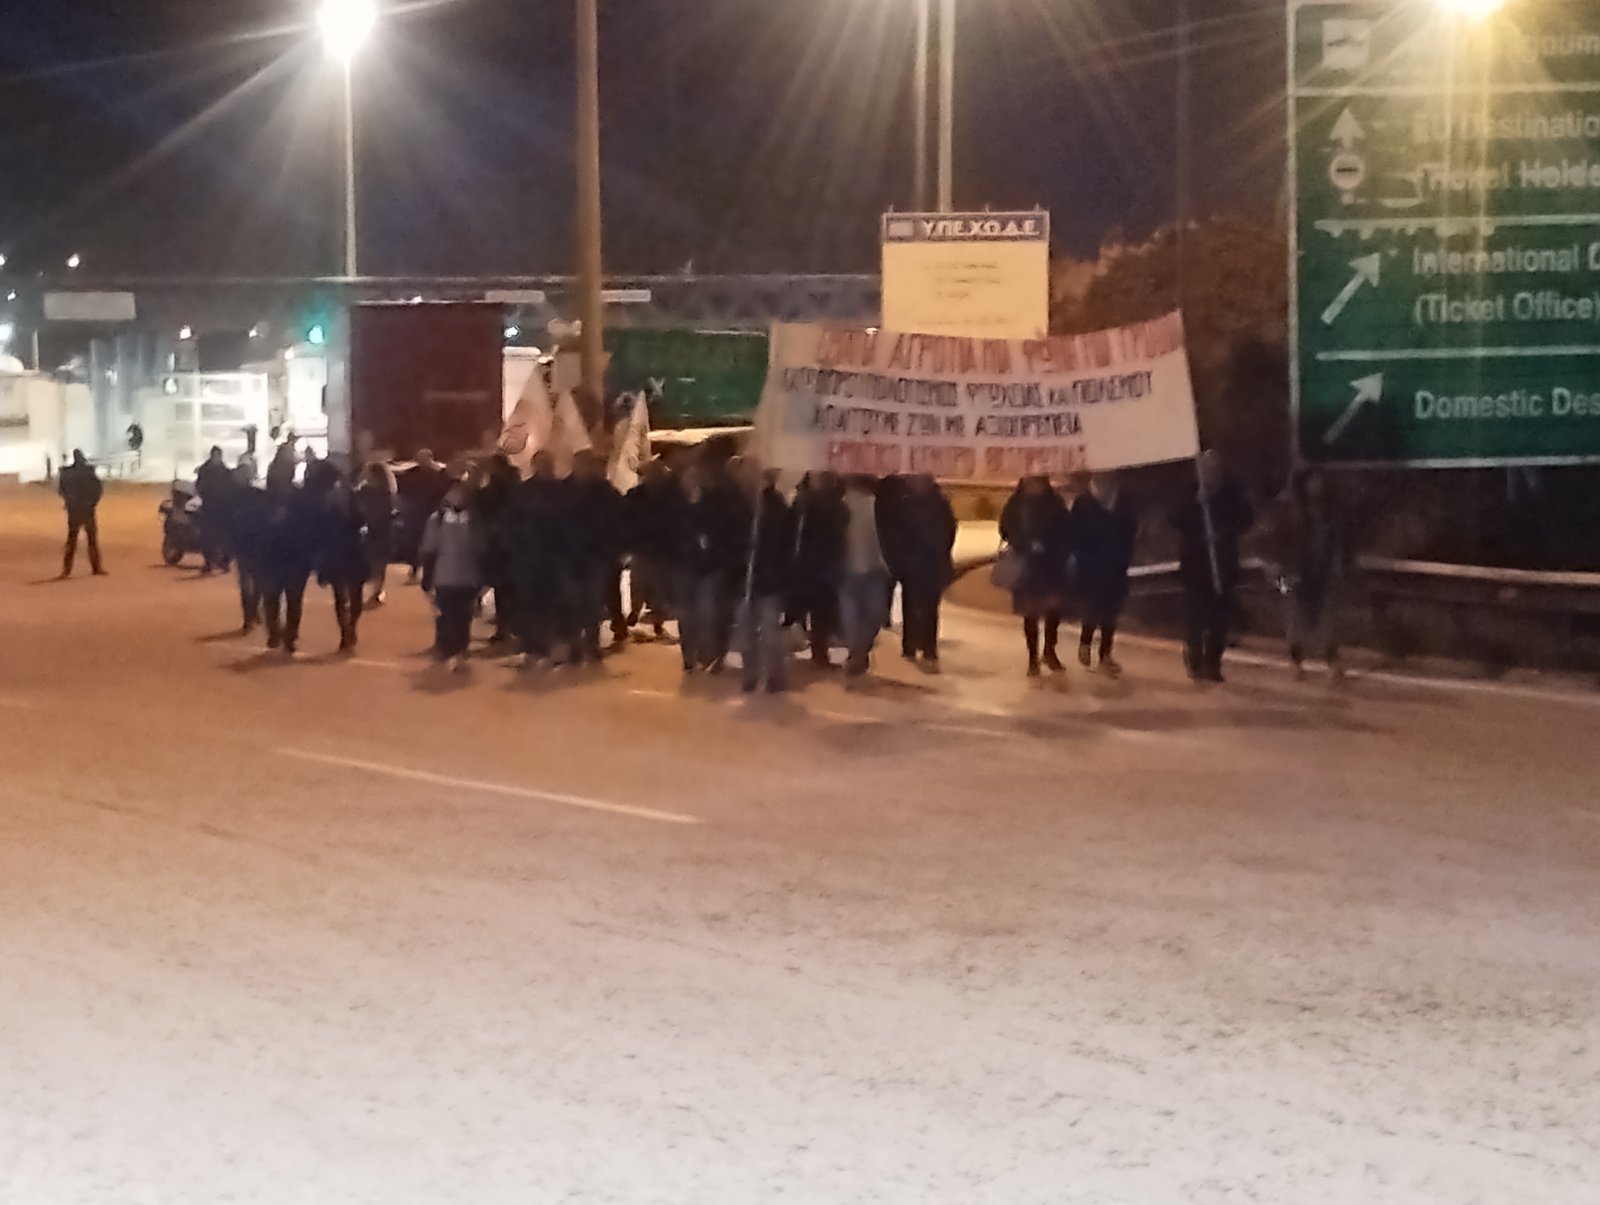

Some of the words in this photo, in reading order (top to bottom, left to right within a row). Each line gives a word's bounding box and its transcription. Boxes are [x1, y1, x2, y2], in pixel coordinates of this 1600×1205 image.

[1413, 244, 1580, 277] International
[1413, 292, 1505, 326] (Ticket
[1414, 388, 1544, 420] Domestic
